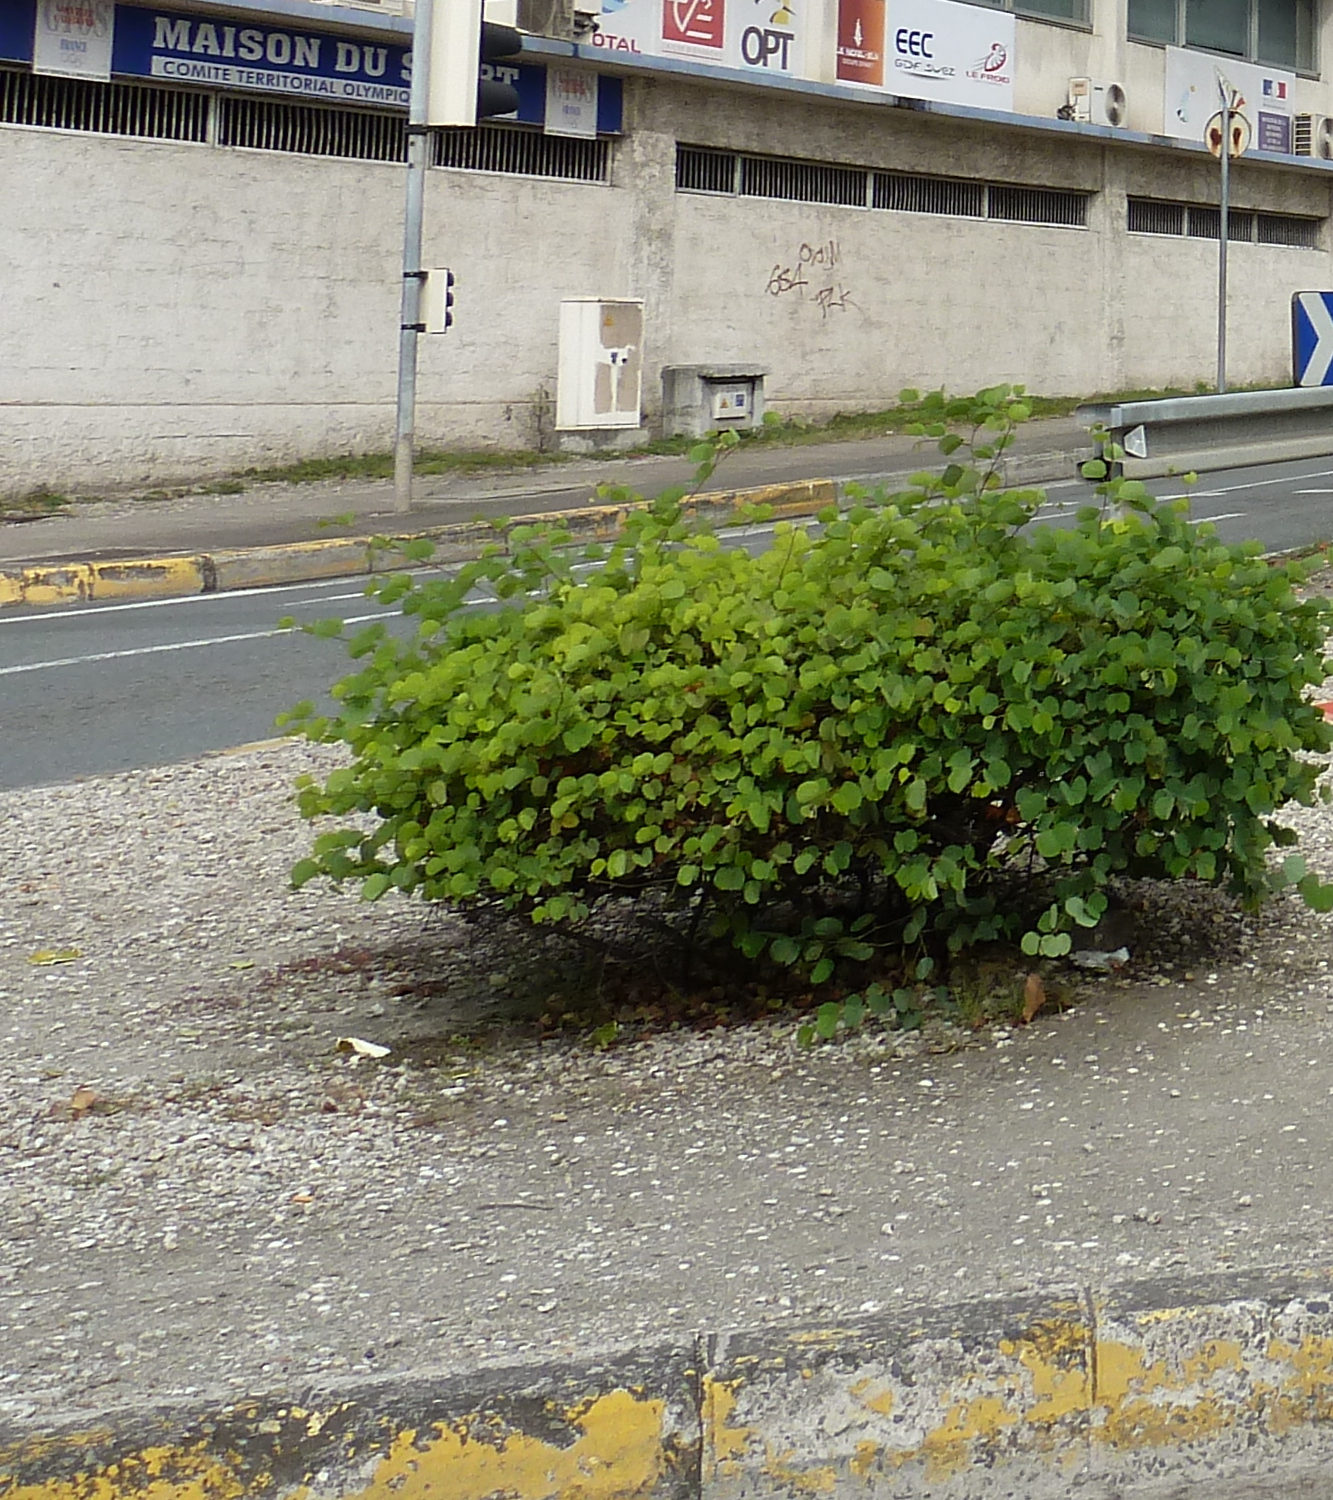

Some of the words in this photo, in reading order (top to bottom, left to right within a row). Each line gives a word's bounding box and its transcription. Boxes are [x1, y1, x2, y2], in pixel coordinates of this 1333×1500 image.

[152, 15, 323, 69] MAISON
[334, 40, 389, 78] DU
[591, 32, 643, 55] OTAL
[741, 25, 796, 72] OPT
[895, 27, 935, 59] EEC
[163, 59, 232, 82] COMITE
[236, 69, 338, 95] TERRITORIAL
[965, 70, 979, 80] LE
[980, 72, 1011, 84] FROID
